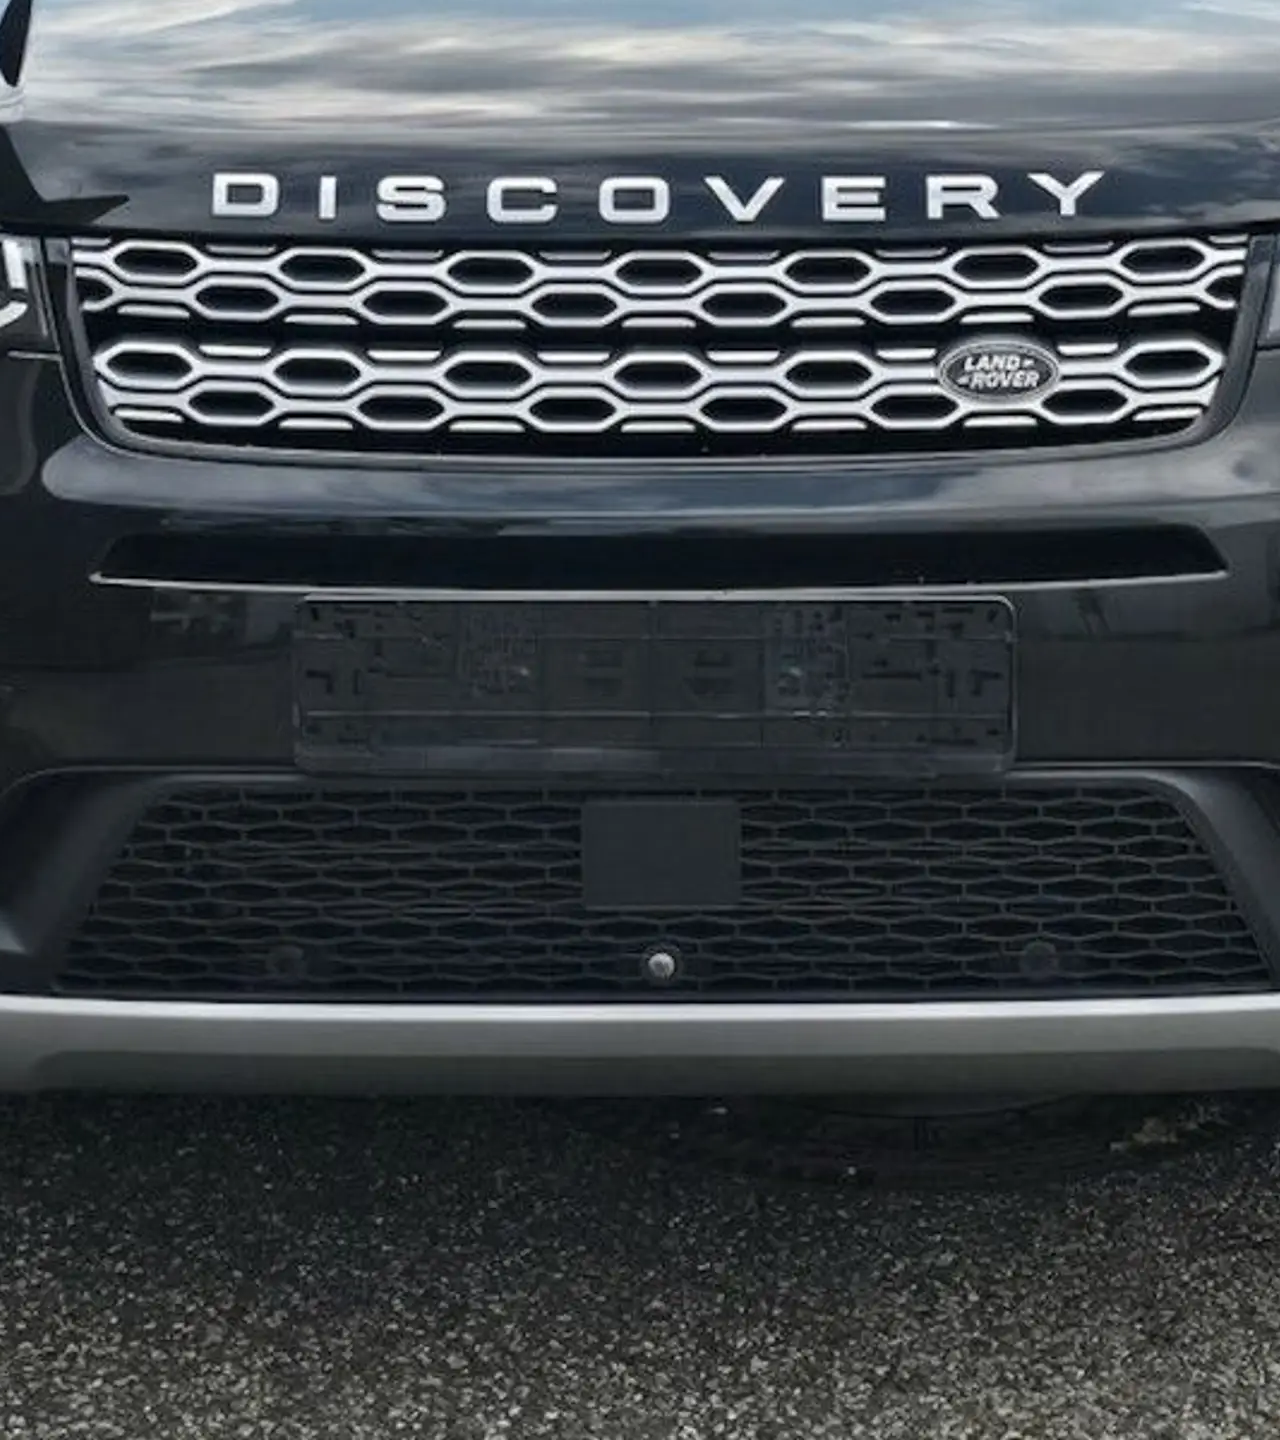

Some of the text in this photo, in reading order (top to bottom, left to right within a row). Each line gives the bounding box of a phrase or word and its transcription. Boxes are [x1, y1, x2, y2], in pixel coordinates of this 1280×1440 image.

[211, 171, 1105, 223] DISCOVERY
[964, 354, 1021, 371] LAND
[971, 370, 1040, 389] ROVER
